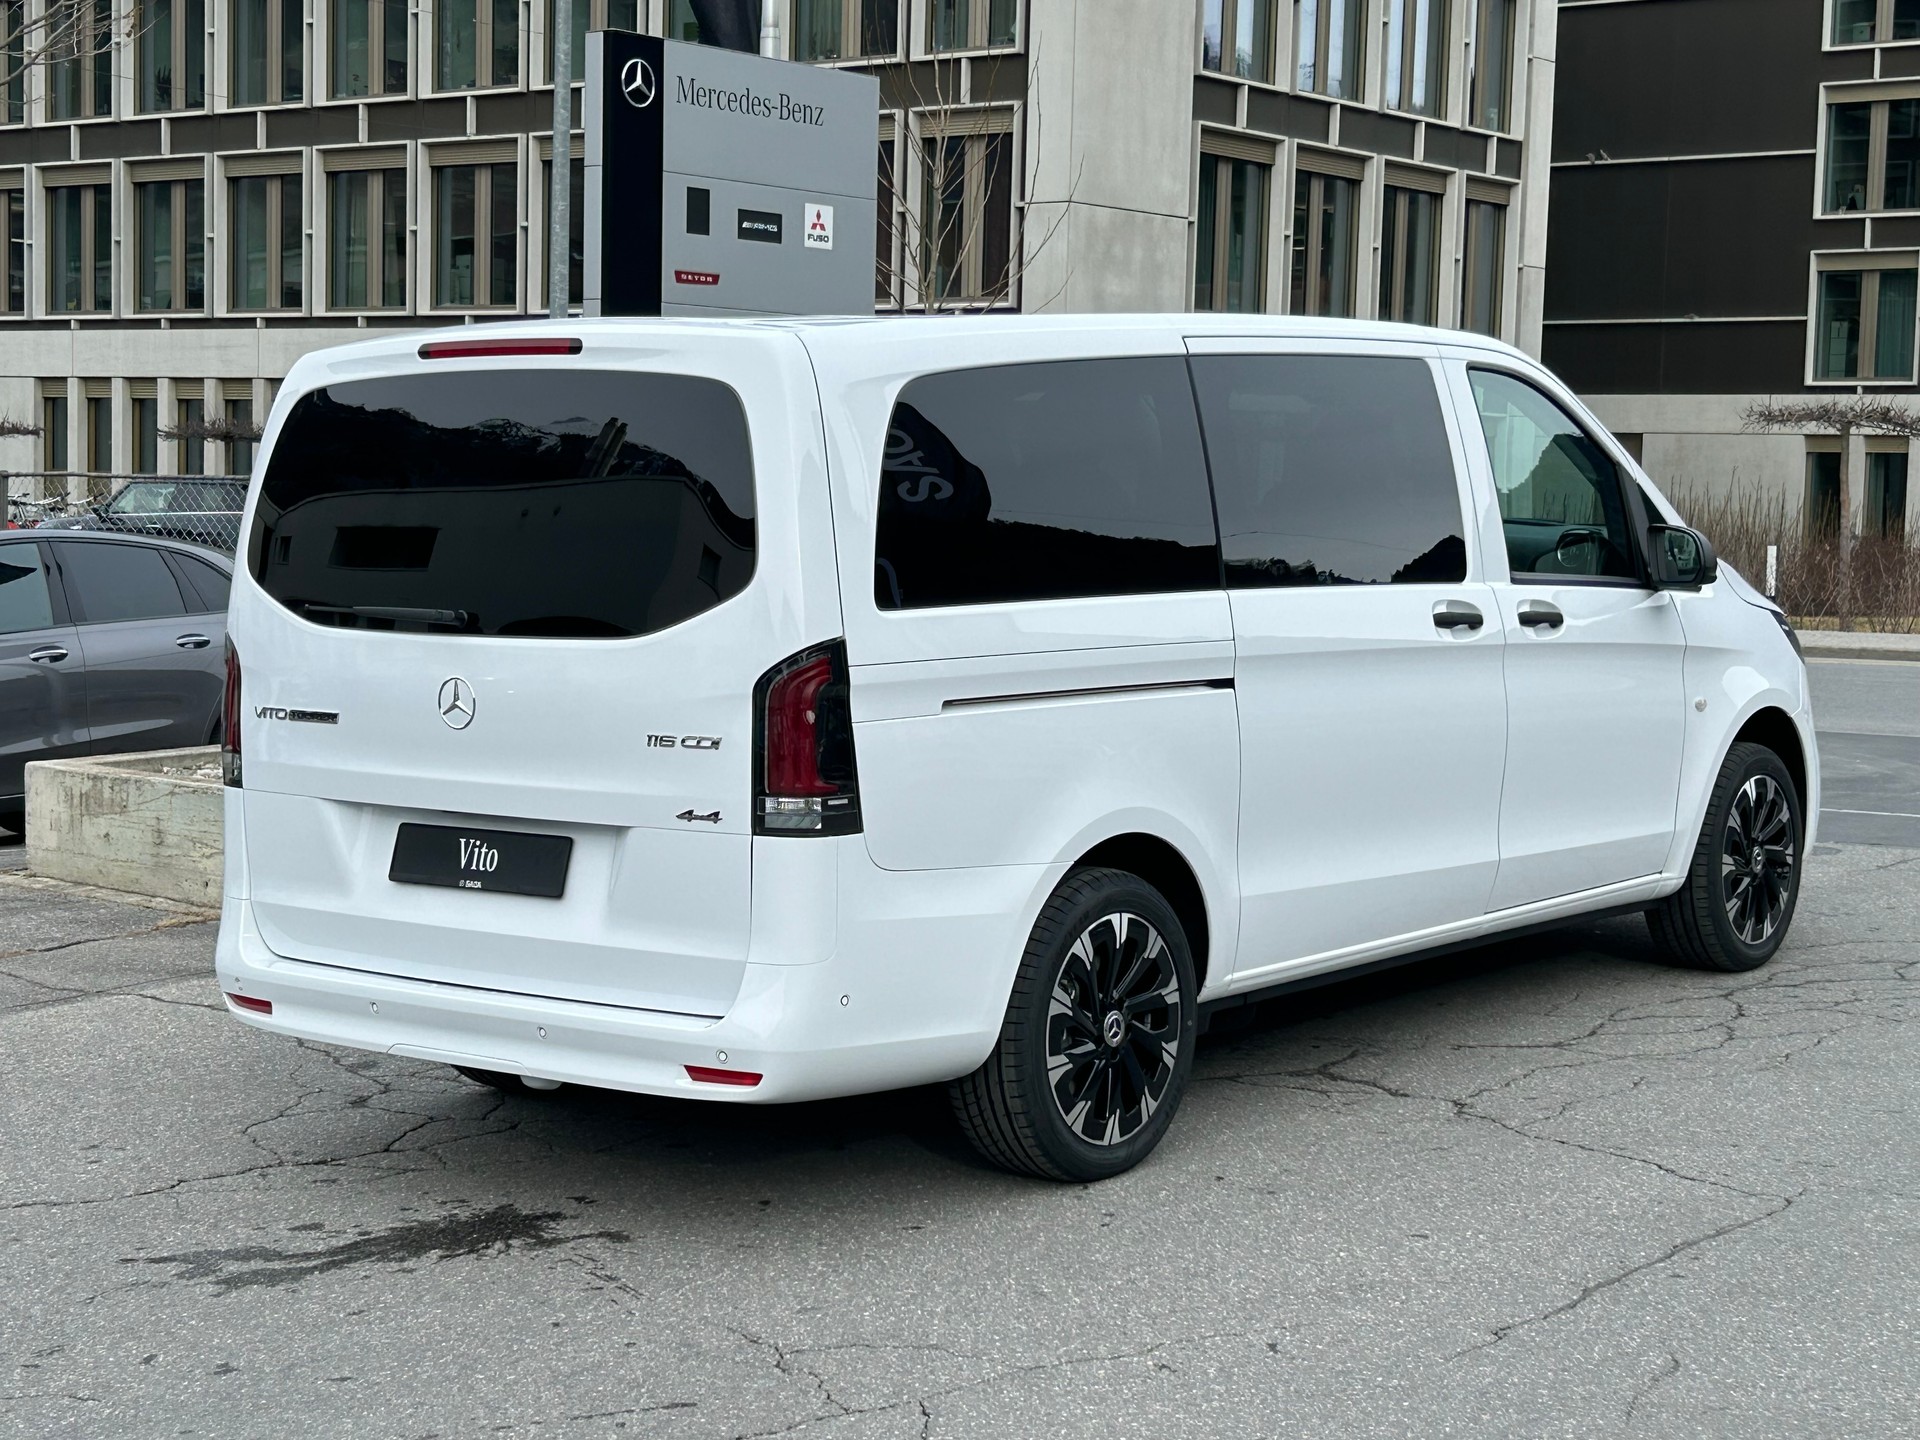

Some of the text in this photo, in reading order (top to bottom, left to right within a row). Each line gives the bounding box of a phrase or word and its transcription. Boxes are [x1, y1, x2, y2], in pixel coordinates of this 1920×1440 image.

[676, 75, 824, 126] Mercedes-Benz
[807, 233, 830, 243] FUSO
[254, 706, 288, 720] VITO
[646, 734, 677, 748] 116
[459, 838, 499, 872] Vito
